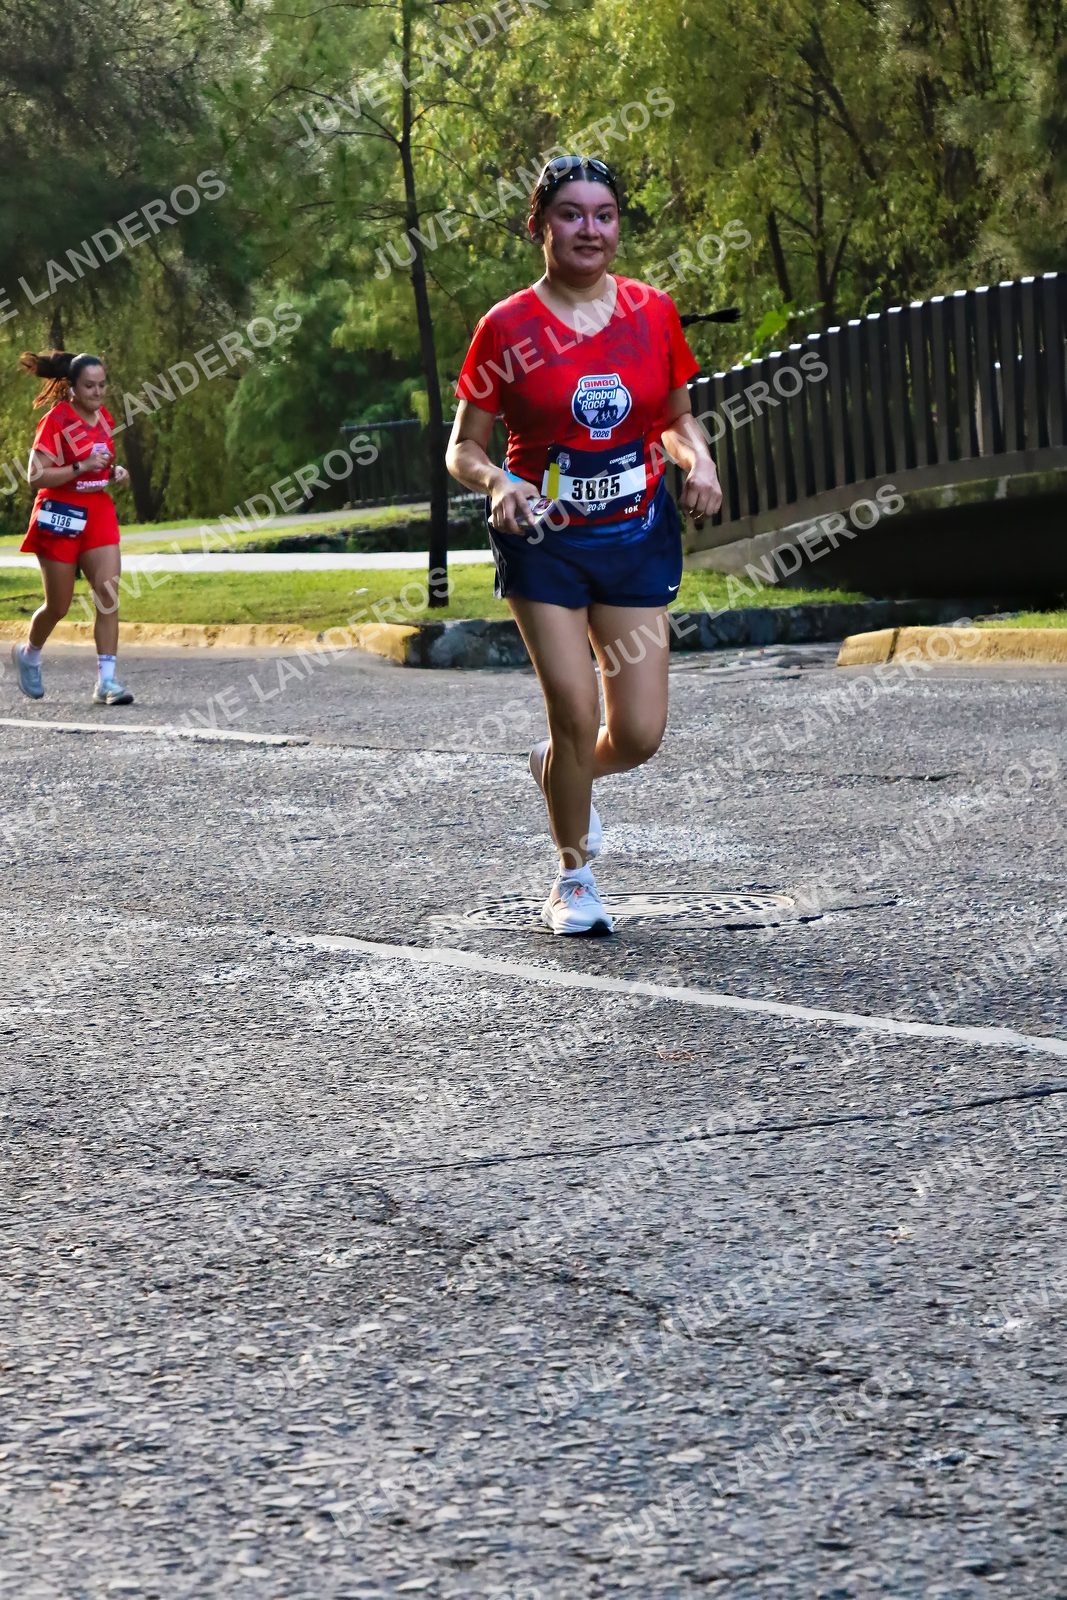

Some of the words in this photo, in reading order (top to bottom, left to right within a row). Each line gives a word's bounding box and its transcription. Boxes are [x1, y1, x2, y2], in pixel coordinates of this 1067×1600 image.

[583, 379, 616, 388] BIMBO
[586, 389, 617, 401] Global
[581, 400, 606, 411] Race
[592, 430, 610, 438] 2026
[571, 475, 620, 501] 3885
[623, 505, 639, 514] 10K
[51, 514, 71, 526] 5136
